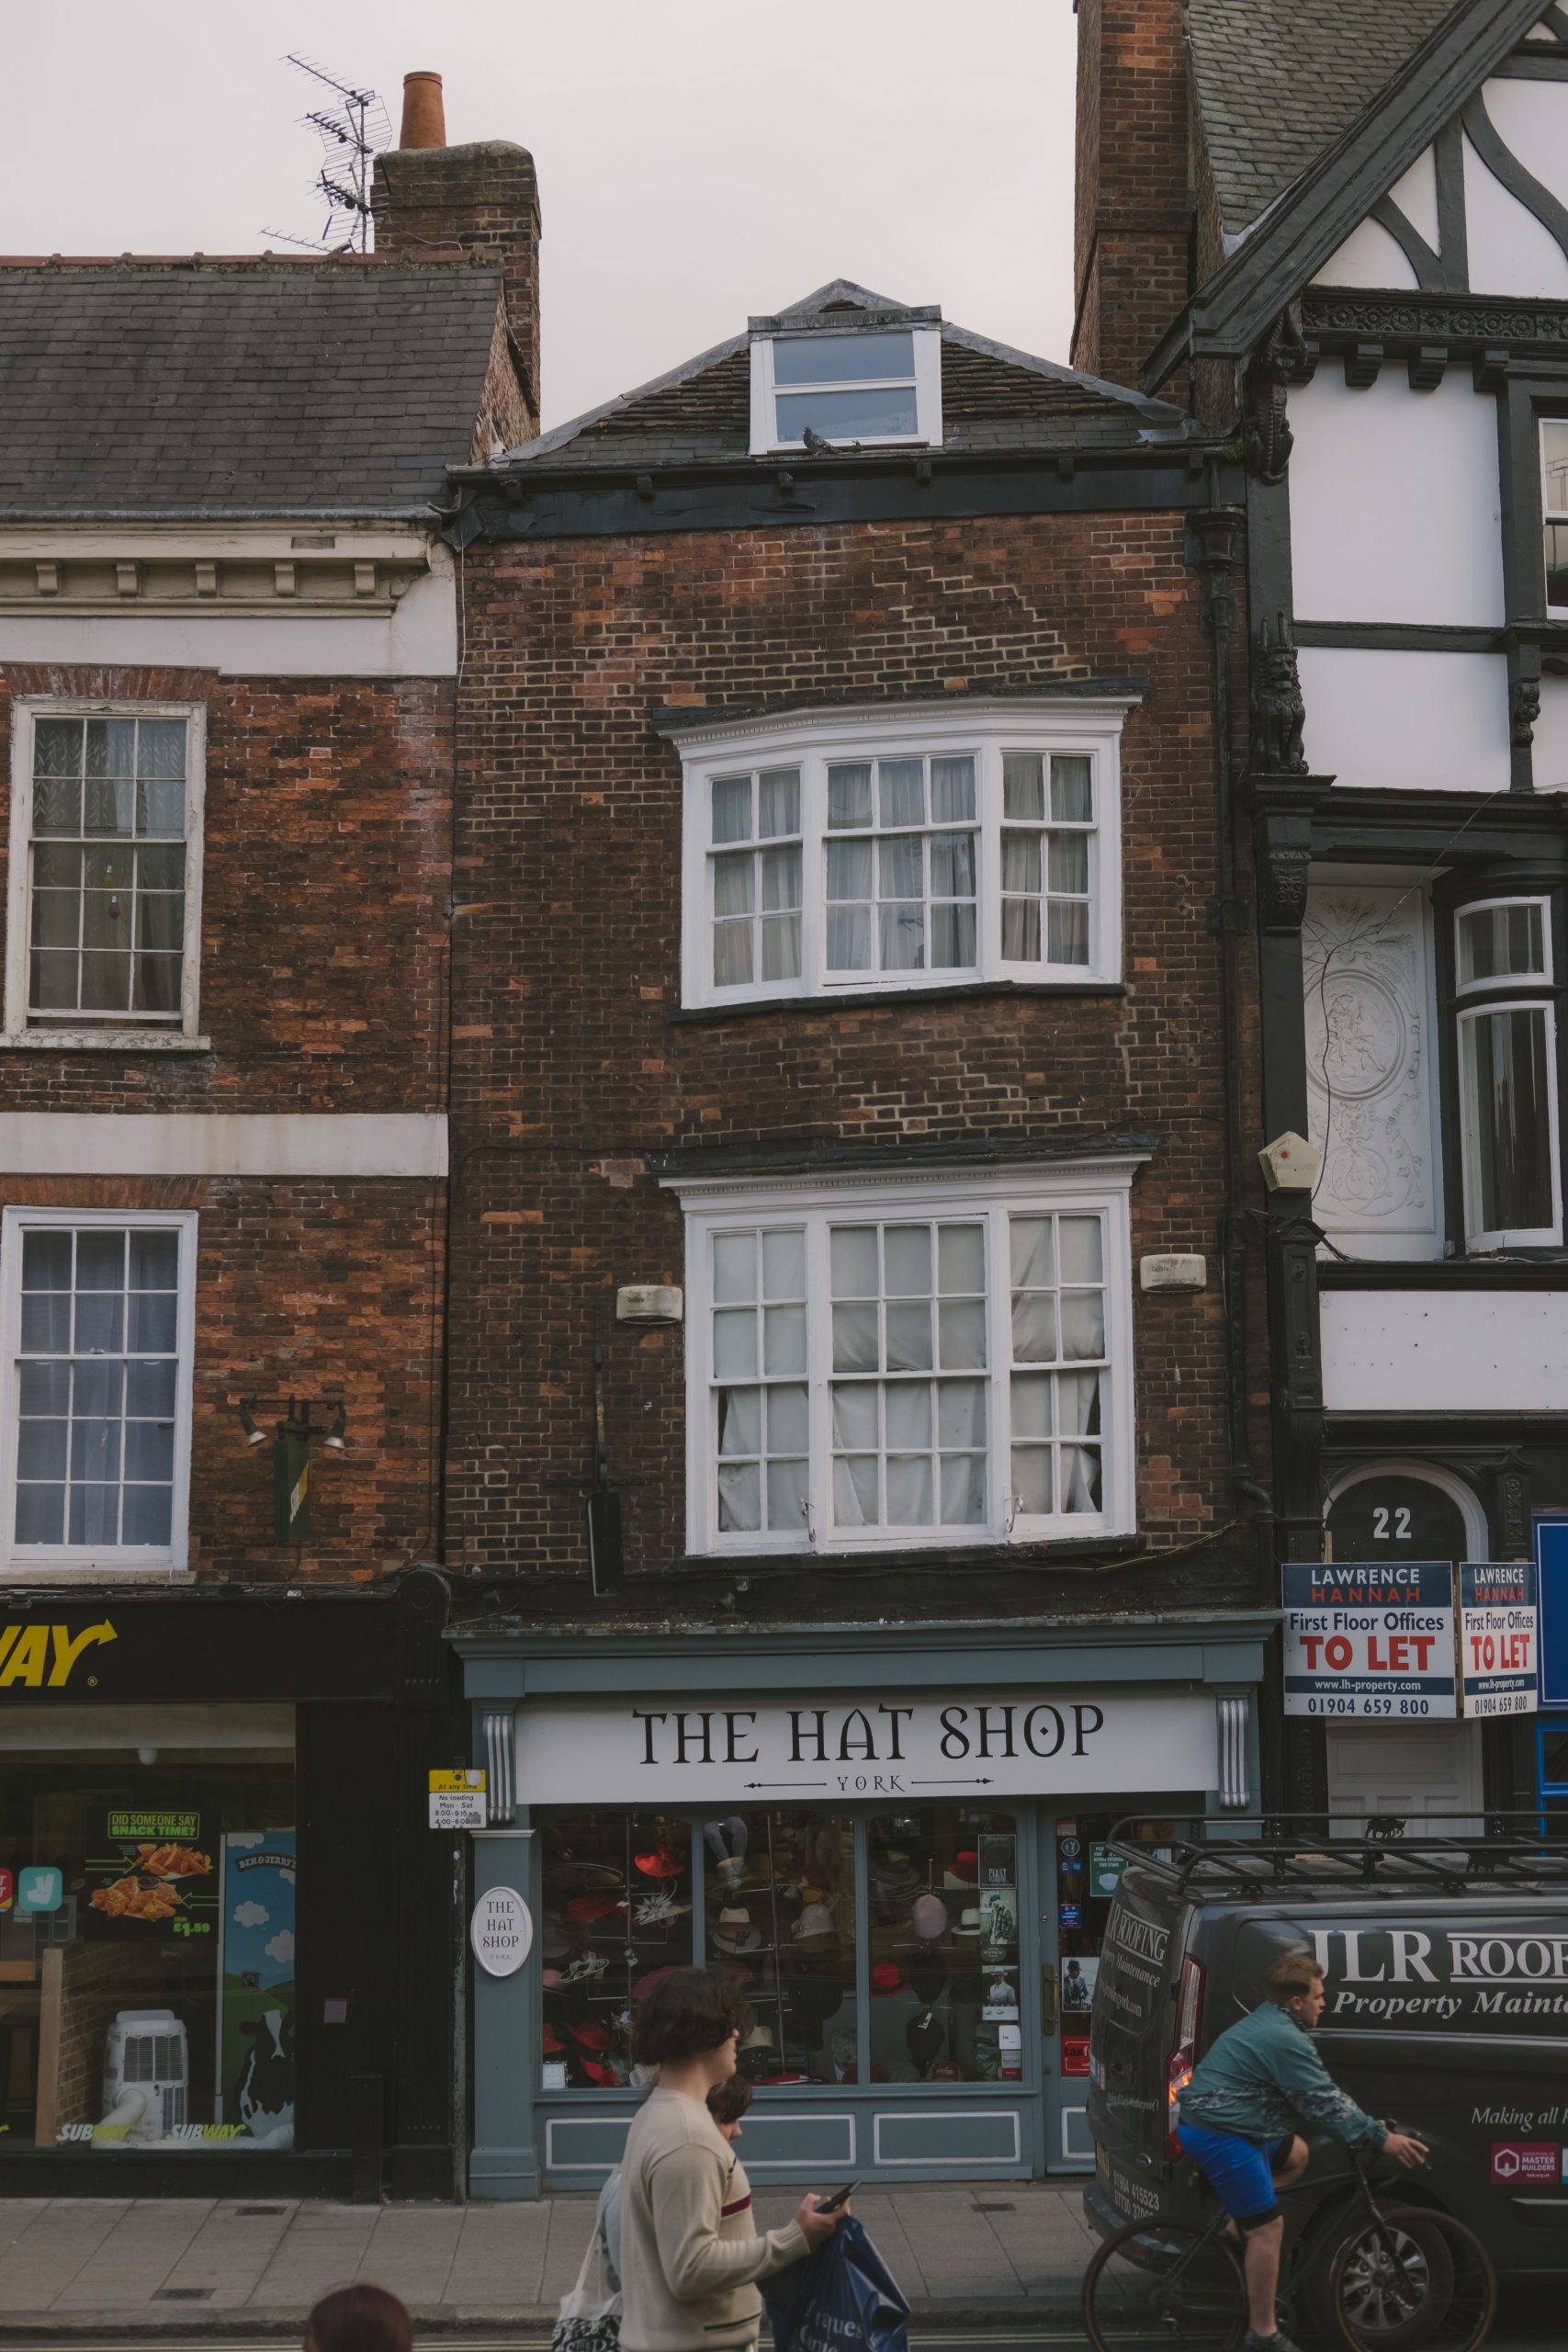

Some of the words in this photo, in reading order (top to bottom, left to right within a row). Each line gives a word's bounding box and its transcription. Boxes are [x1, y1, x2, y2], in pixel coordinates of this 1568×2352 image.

[1372, 1507, 1412, 1539] 22
[1311, 1568, 1420, 1585] LAWRENCE
[1474, 1568, 1524, 1584] LAWRENCE
[1311, 1587, 1421, 1603] HANNAH
[1474, 1587, 1525, 1602] HANNAH
[1290, 1612, 1327, 1631] First
[1334, 1612, 1378, 1631] Floor
[1383, 1611, 1444, 1631] Offices
[1465, 1612, 1484, 1631] First
[1486, 1612, 1506, 1630] Floor
[1507, 1611, 1534, 1630] Offices
[1299, 1635, 1353, 1671] TO
[1367, 1635, 1436, 1671] LET
[1470, 1634, 1495, 1671] TO
[1500, 1634, 1530, 1669] LET
[1314, 1679, 1422, 1692] www.lh-property.com
[1477, 1678, 1525, 1691] www.lh-property.com
[1308, 1698, 1355, 1713] 01904
[1363, 1699, 1392, 1714] 659
[1400, 1700, 1429, 1715] 800
[1474, 1698, 1496, 1714] 01904
[1499, 1697, 1512, 1713] 659
[1514, 1696, 1528, 1711] 800
[632, 1707, 760, 1766] THE
[786, 1702, 914, 1763] HAT
[939, 1703, 1104, 1760] SHOP
[836, 1774, 907, 1793] YORK
[111, 1814, 130, 1825] DID
[130, 1815, 177, 1826] SOMEONE
[178, 1815, 197, 1826] SAY
[111, 1826, 155, 1836] SNACK
[158, 1826, 197, 1837] TIME?
[487, 1901, 515, 1913] THE
[173, 1922, 211, 1937] £1.59
[487, 1917, 515, 1931] HAT
[482, 1935, 519, 1949] SHOP
[1117, 1912, 1168, 1962] ROOFING
[1308, 1929, 1440, 1983] JLR
[1117, 1952, 1160, 1987] Maintenance
[1332, 1991, 1462, 2020] Property
[1471, 2106, 1534, 2132] Making
[1538, 2106, 1559, 2124] all
[169, 2123, 247, 2141] SUBWAY
[1521, 2156, 1555, 2165] MASTER
[1132, 2183, 1160, 2211] 415523
